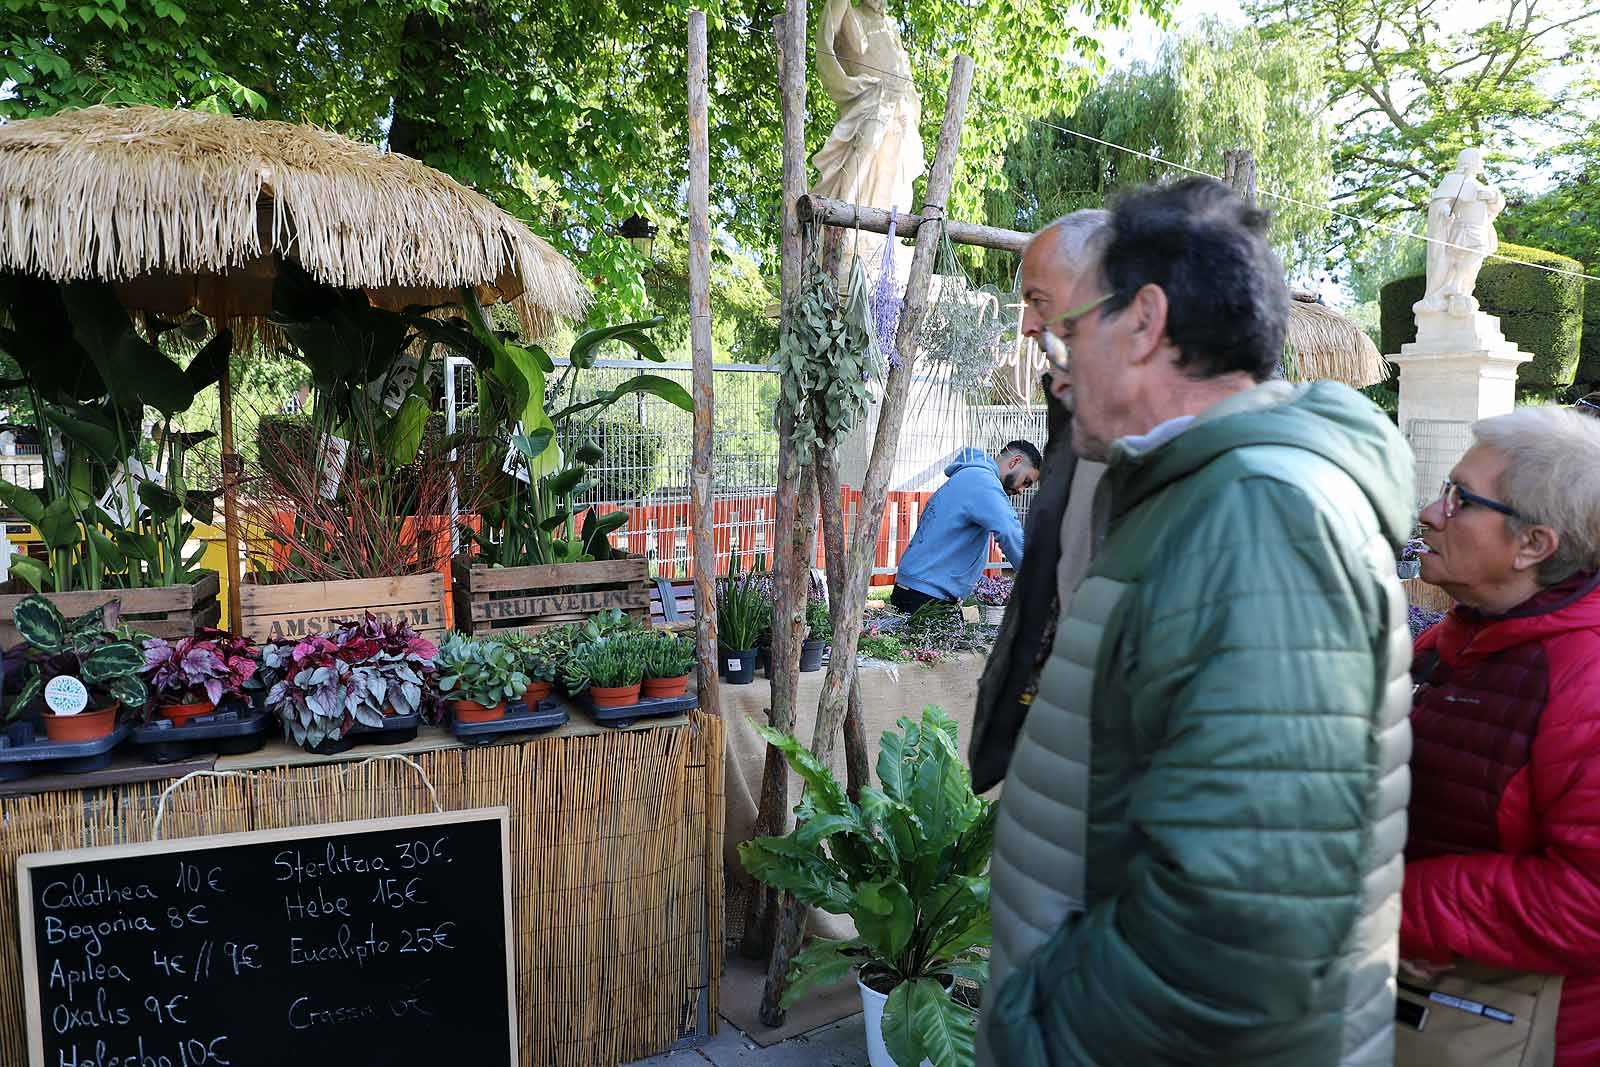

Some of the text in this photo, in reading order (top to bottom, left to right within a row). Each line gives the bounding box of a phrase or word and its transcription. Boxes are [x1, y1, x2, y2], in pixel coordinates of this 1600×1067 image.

[481, 591, 643, 619] FRUITVEILING
[42, 861, 225, 908] Calathea 10€
[286, 877, 430, 920] Hebe 15€
[44, 905, 209, 956] Begonia 8€
[291, 922, 456, 967] Eucalipto 25€
[49, 955, 131, 1001] Apilea
[153, 950, 187, 976] 4€
[223, 942, 262, 975] 9€
[53, 987, 189, 1033] Oxalis 9€
[179, 1035, 230, 1067] 10€
